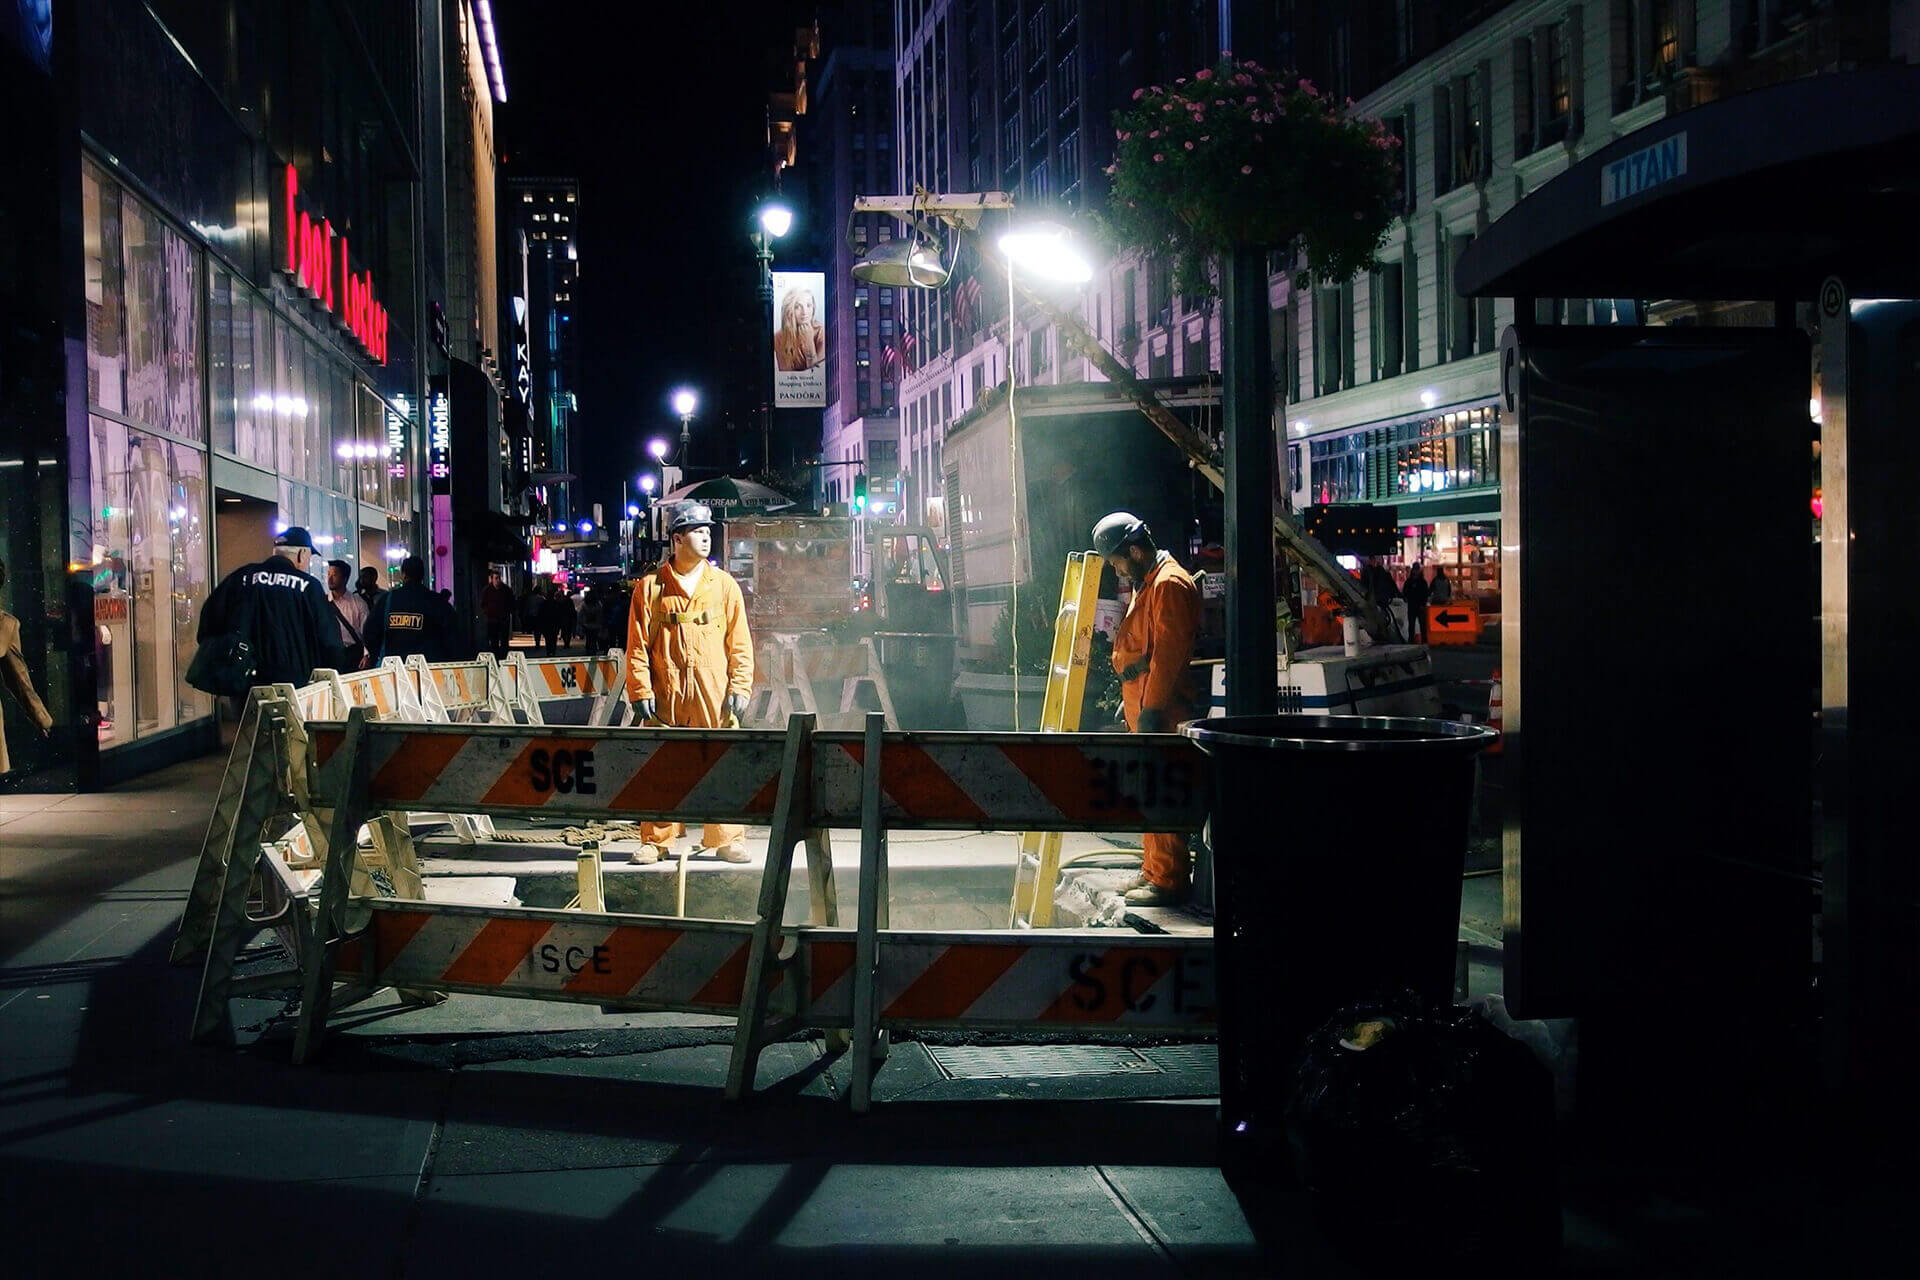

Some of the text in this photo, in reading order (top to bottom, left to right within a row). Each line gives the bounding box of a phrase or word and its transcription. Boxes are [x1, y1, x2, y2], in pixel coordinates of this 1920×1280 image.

[1611, 137, 1678, 199] TITAN
[516, 343, 530, 404] KAY
[779, 392, 820, 400] PANDORA
[710, 498, 738, 507] CREAM
[387, 615, 421, 628] SECURITY
[561, 666, 577, 688] SCE
[531, 749, 597, 795] SCE
[541, 944, 612, 974] SCE
[1070, 955, 1209, 1013] SCE
